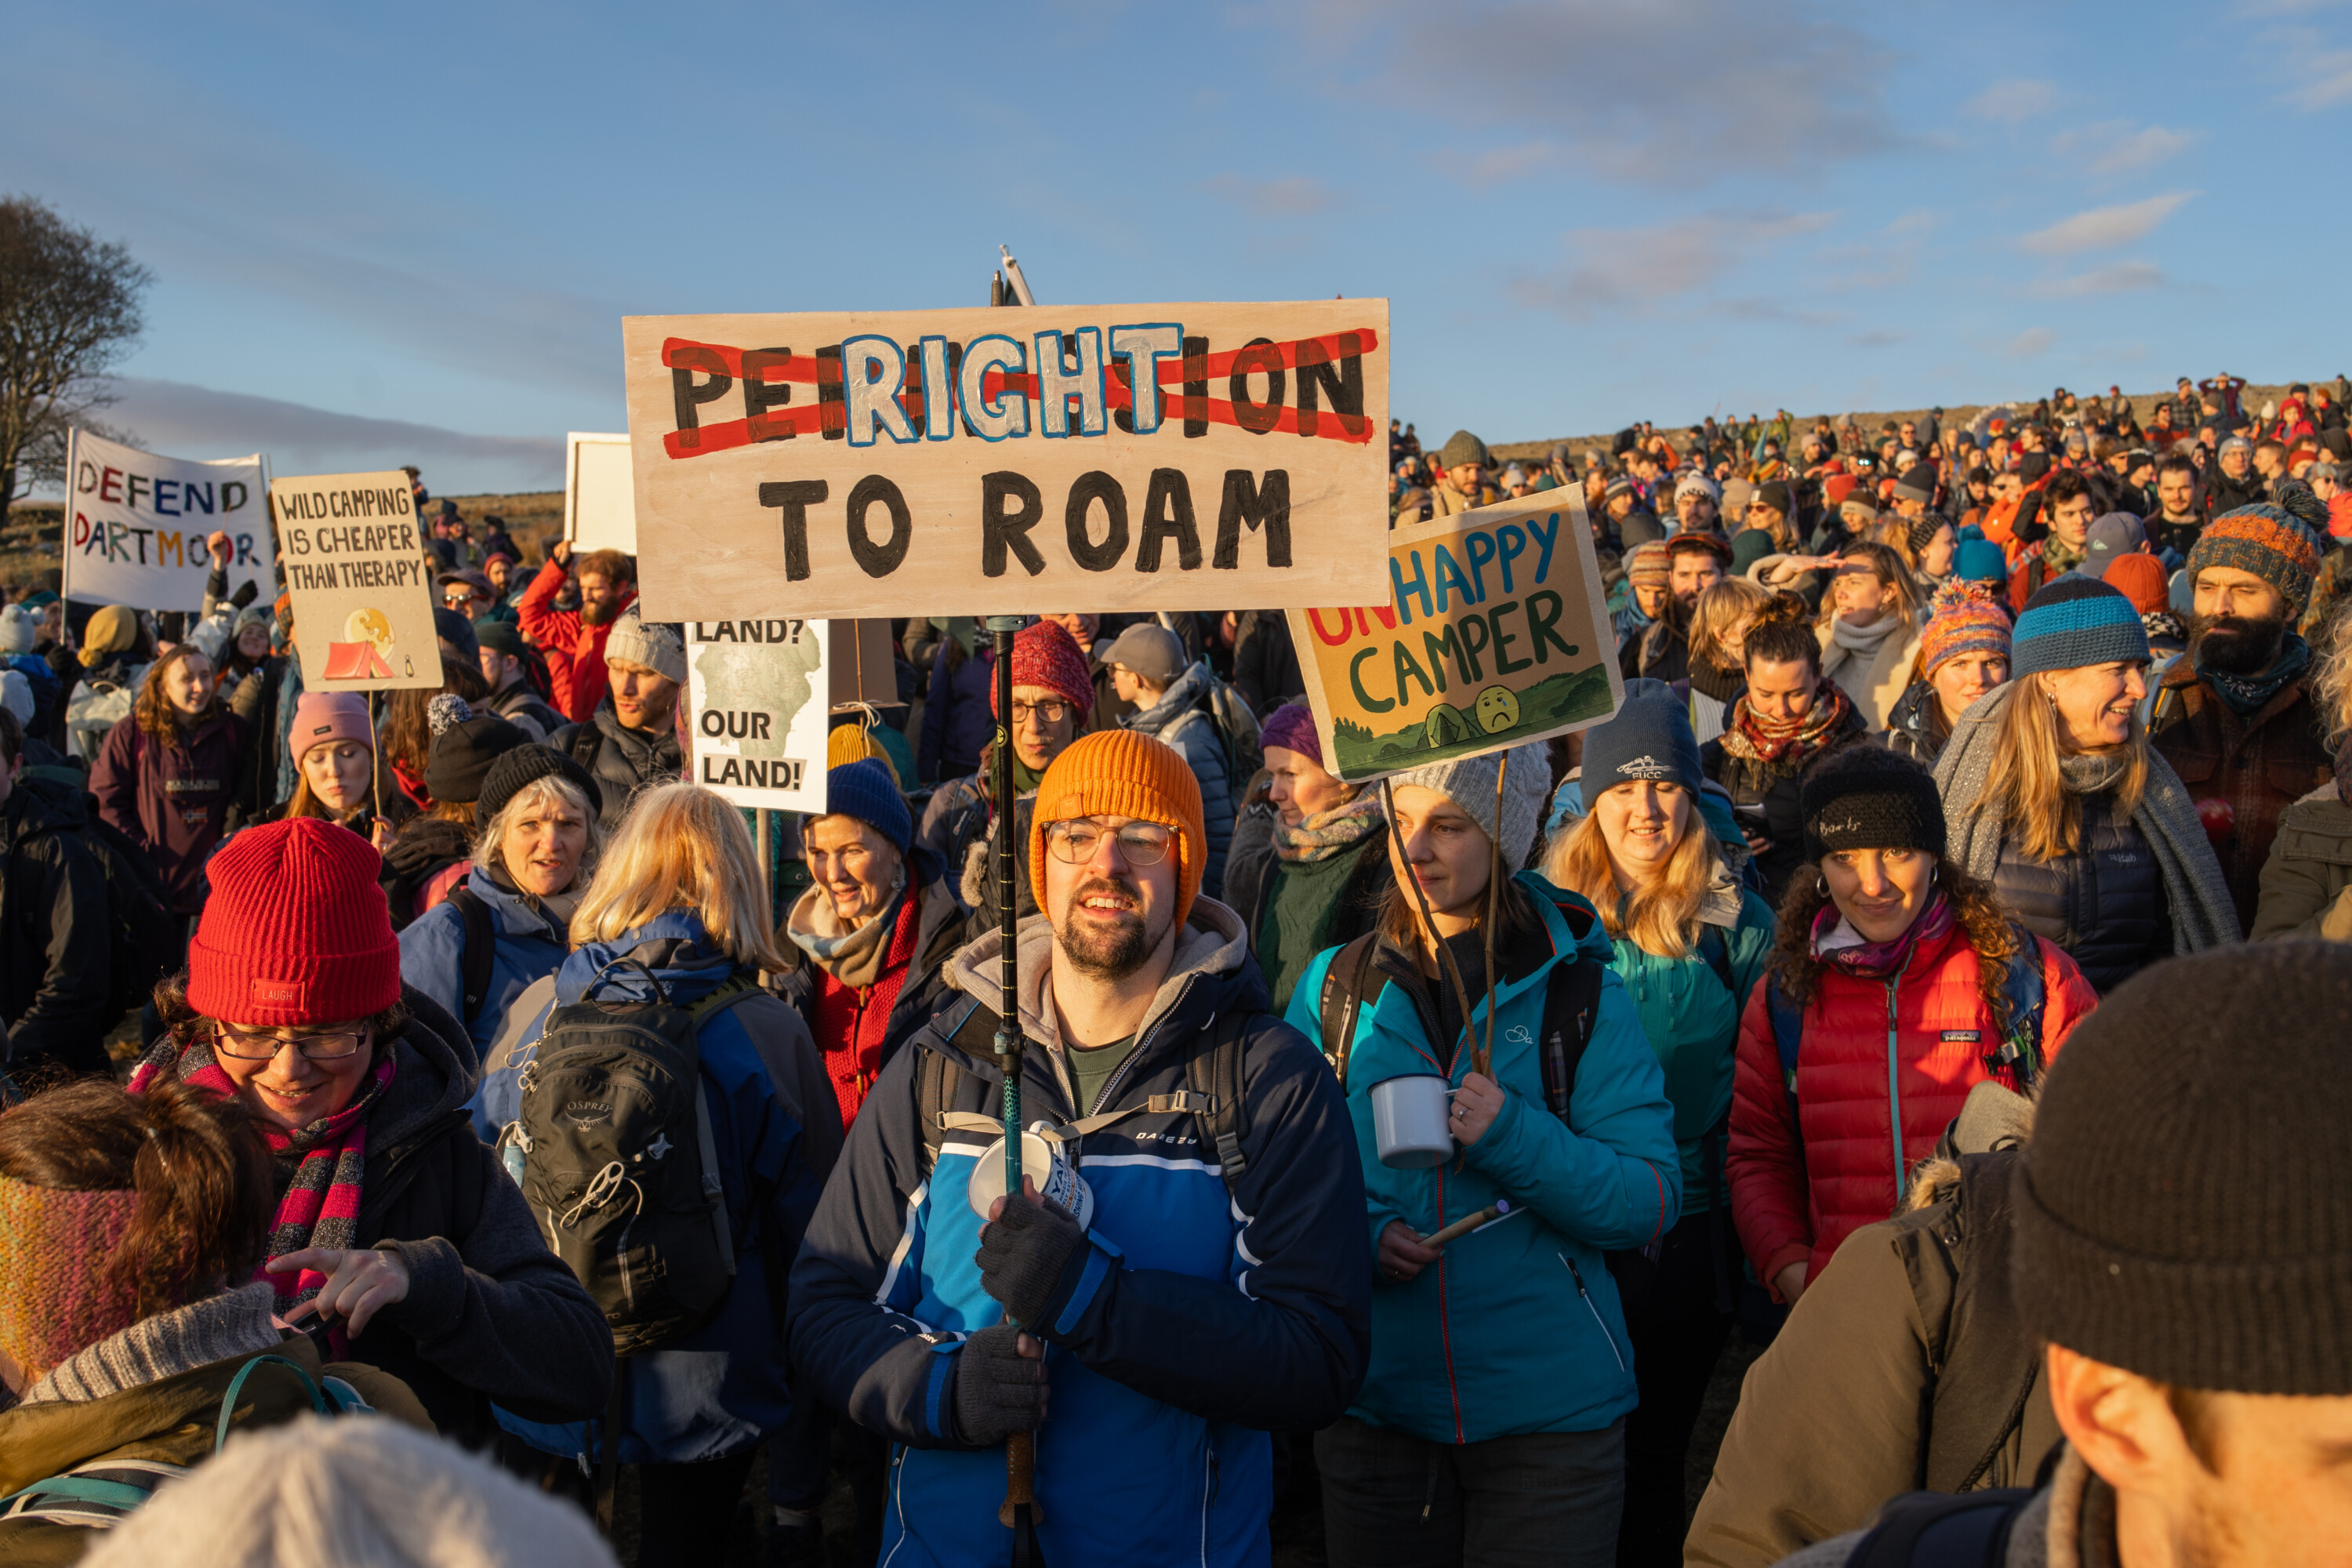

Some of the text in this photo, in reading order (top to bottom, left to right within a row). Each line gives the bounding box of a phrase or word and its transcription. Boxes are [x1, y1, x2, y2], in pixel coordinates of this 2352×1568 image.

[670, 333, 1365, 448] PEION
[841, 323, 1184, 447] RIGHT
[78, 461, 248, 517] DEFEND
[278, 487, 410, 520] WILD CAMPING
[287, 523, 416, 555] IS CHEAPER
[759, 468, 1292, 582] TO ROAM
[289, 559, 420, 590] THAN THERAPY
[696, 619, 804, 644] LAND?
[1349, 590, 1579, 713] CAMPER
[701, 710, 771, 739] OUR
[702, 757, 800, 791] LAND!
[262, 989, 292, 1001] LAUGH
[567, 1101, 614, 1112] OSPREY
[1073, 1191, 1084, 1218] SHING
